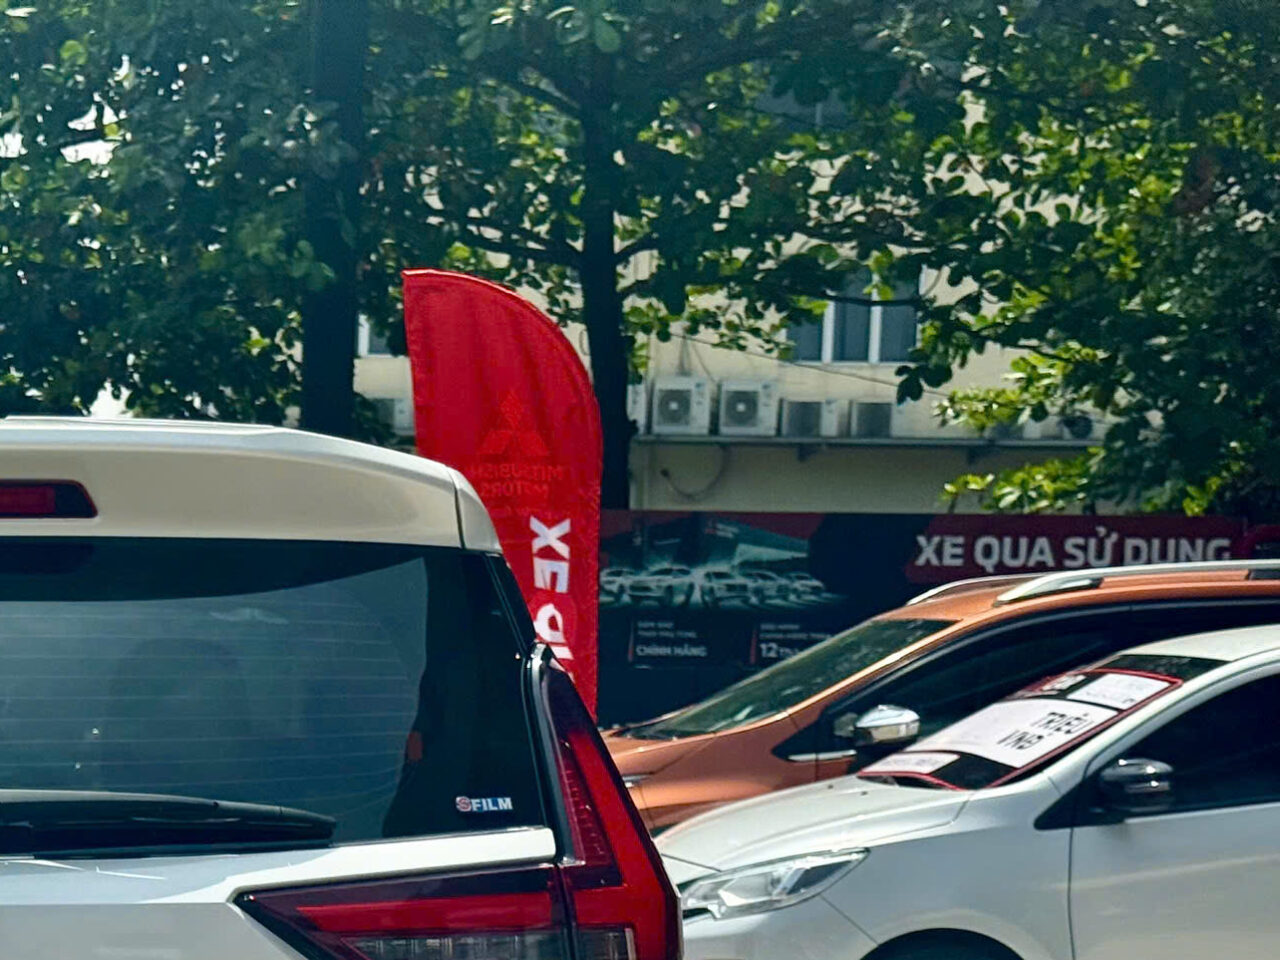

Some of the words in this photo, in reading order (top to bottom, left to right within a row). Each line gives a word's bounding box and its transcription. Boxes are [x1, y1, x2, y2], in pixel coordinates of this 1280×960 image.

[529, 515, 571, 594] XE
[915, 535, 965, 568] XE
[974, 536, 1055, 573] QUA
